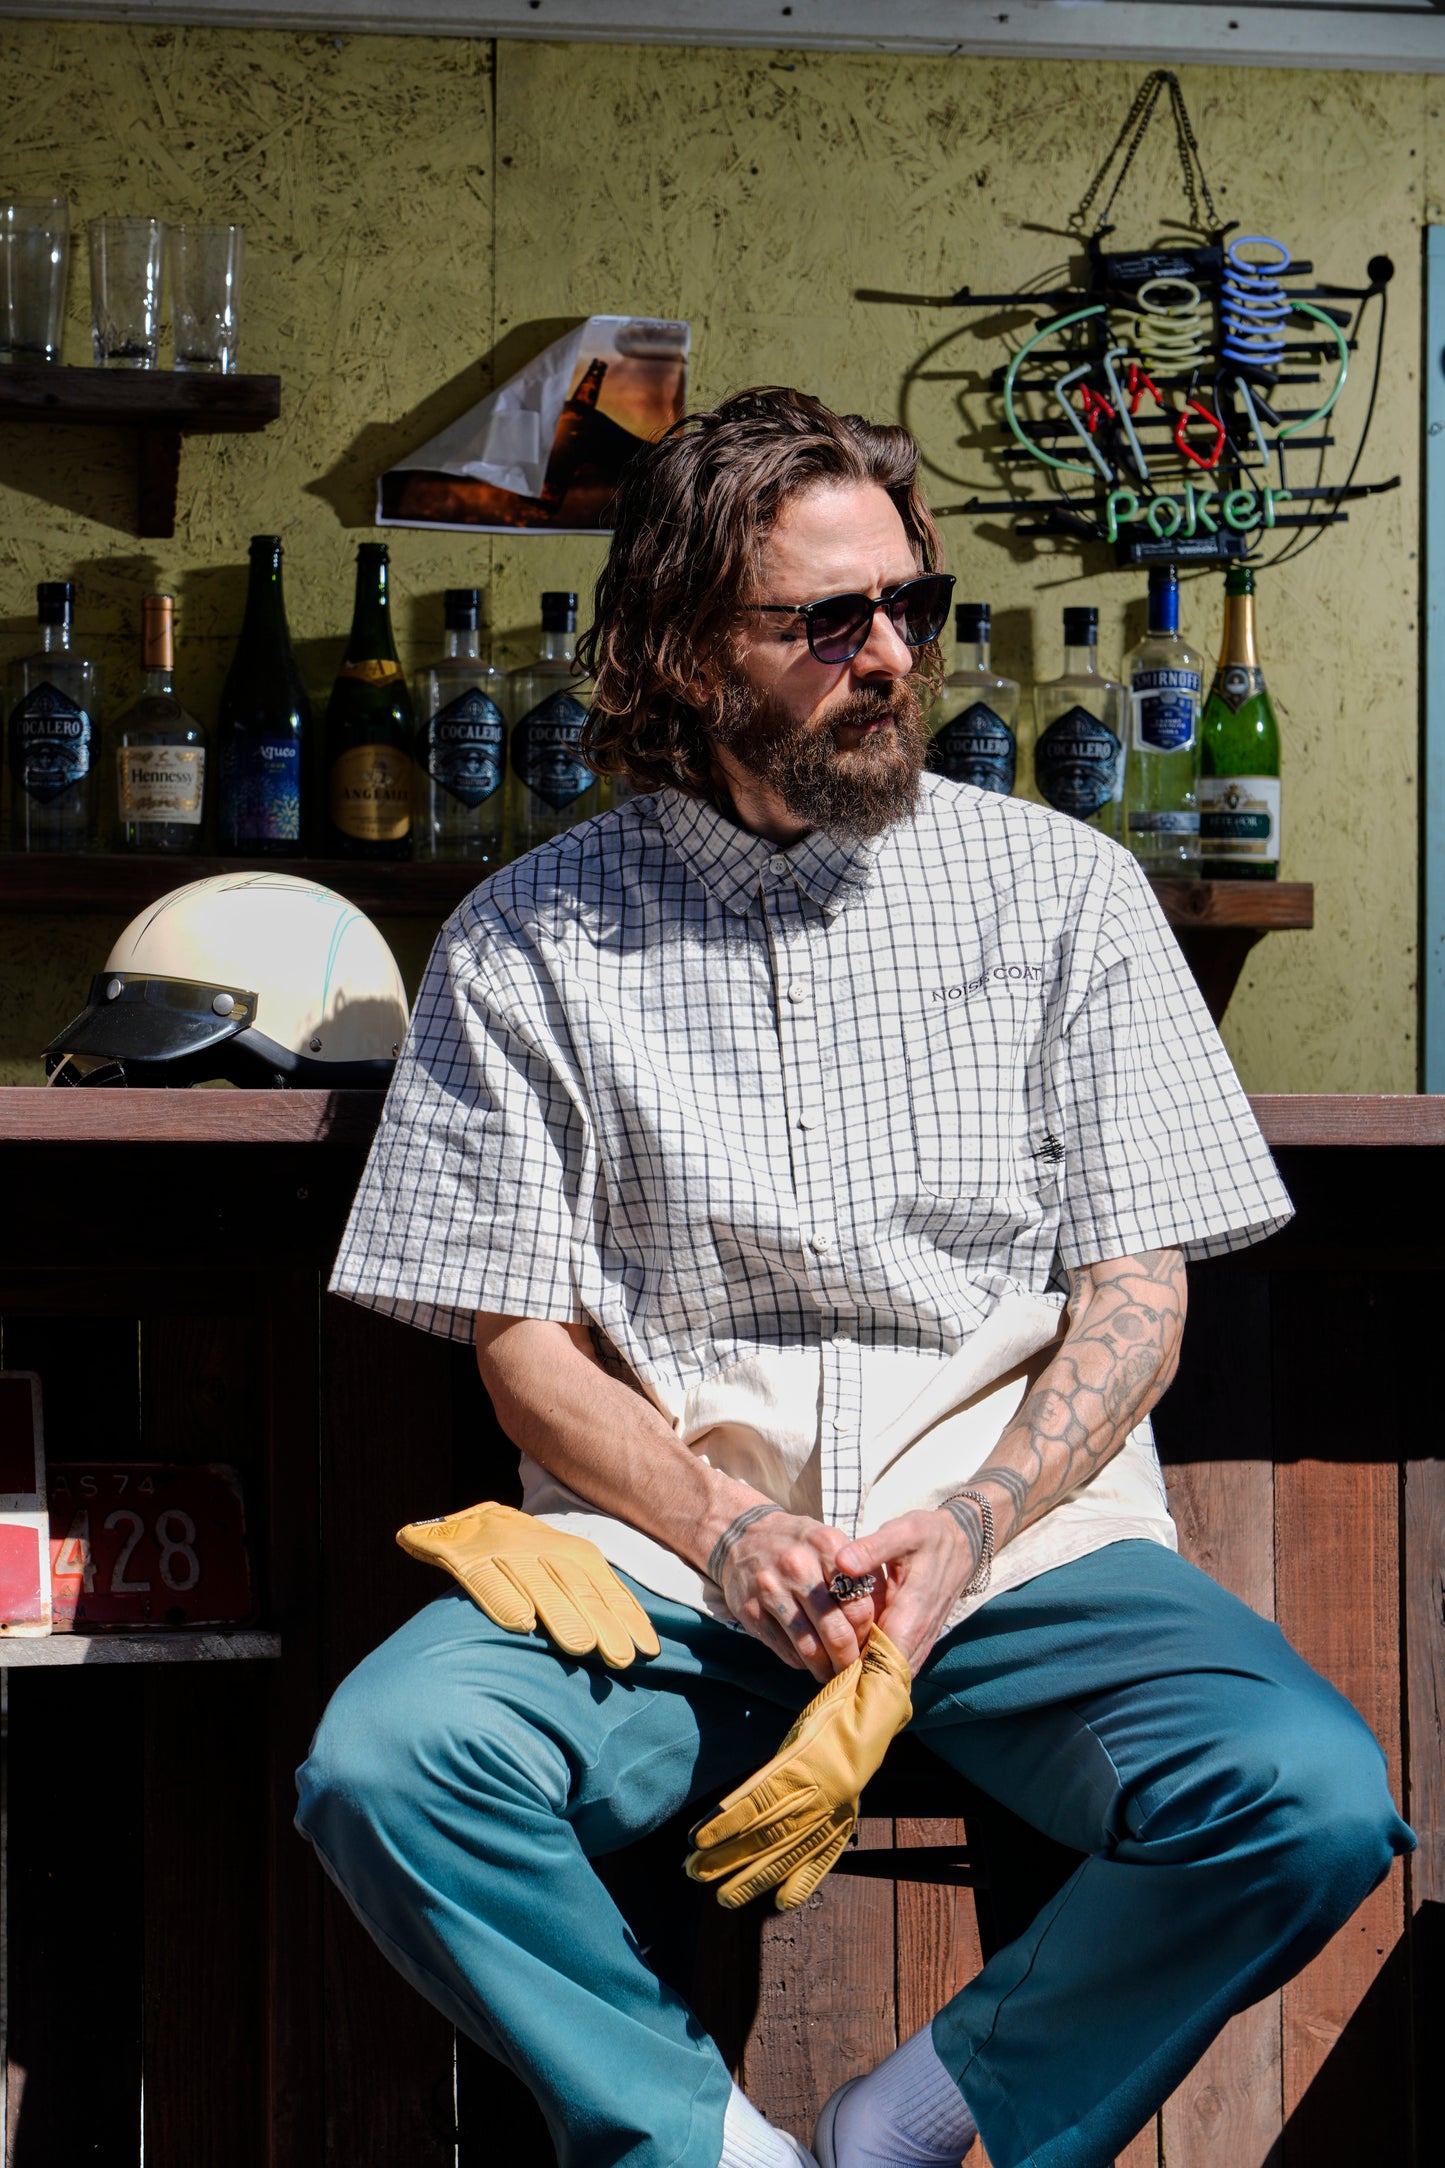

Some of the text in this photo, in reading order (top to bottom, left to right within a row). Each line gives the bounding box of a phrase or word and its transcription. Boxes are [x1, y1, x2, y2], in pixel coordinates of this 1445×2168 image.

[1134, 671, 1199, 689] SMIRNOFF
[15, 719, 81, 737] COCALERO
[527, 726, 581, 742] COCALE
[131, 768, 193, 786] Hennessy
[931, 965, 1042, 1003] NOISE COAT
[112, 1474, 156, 1496] 74
[54, 1509, 201, 1593] 428
